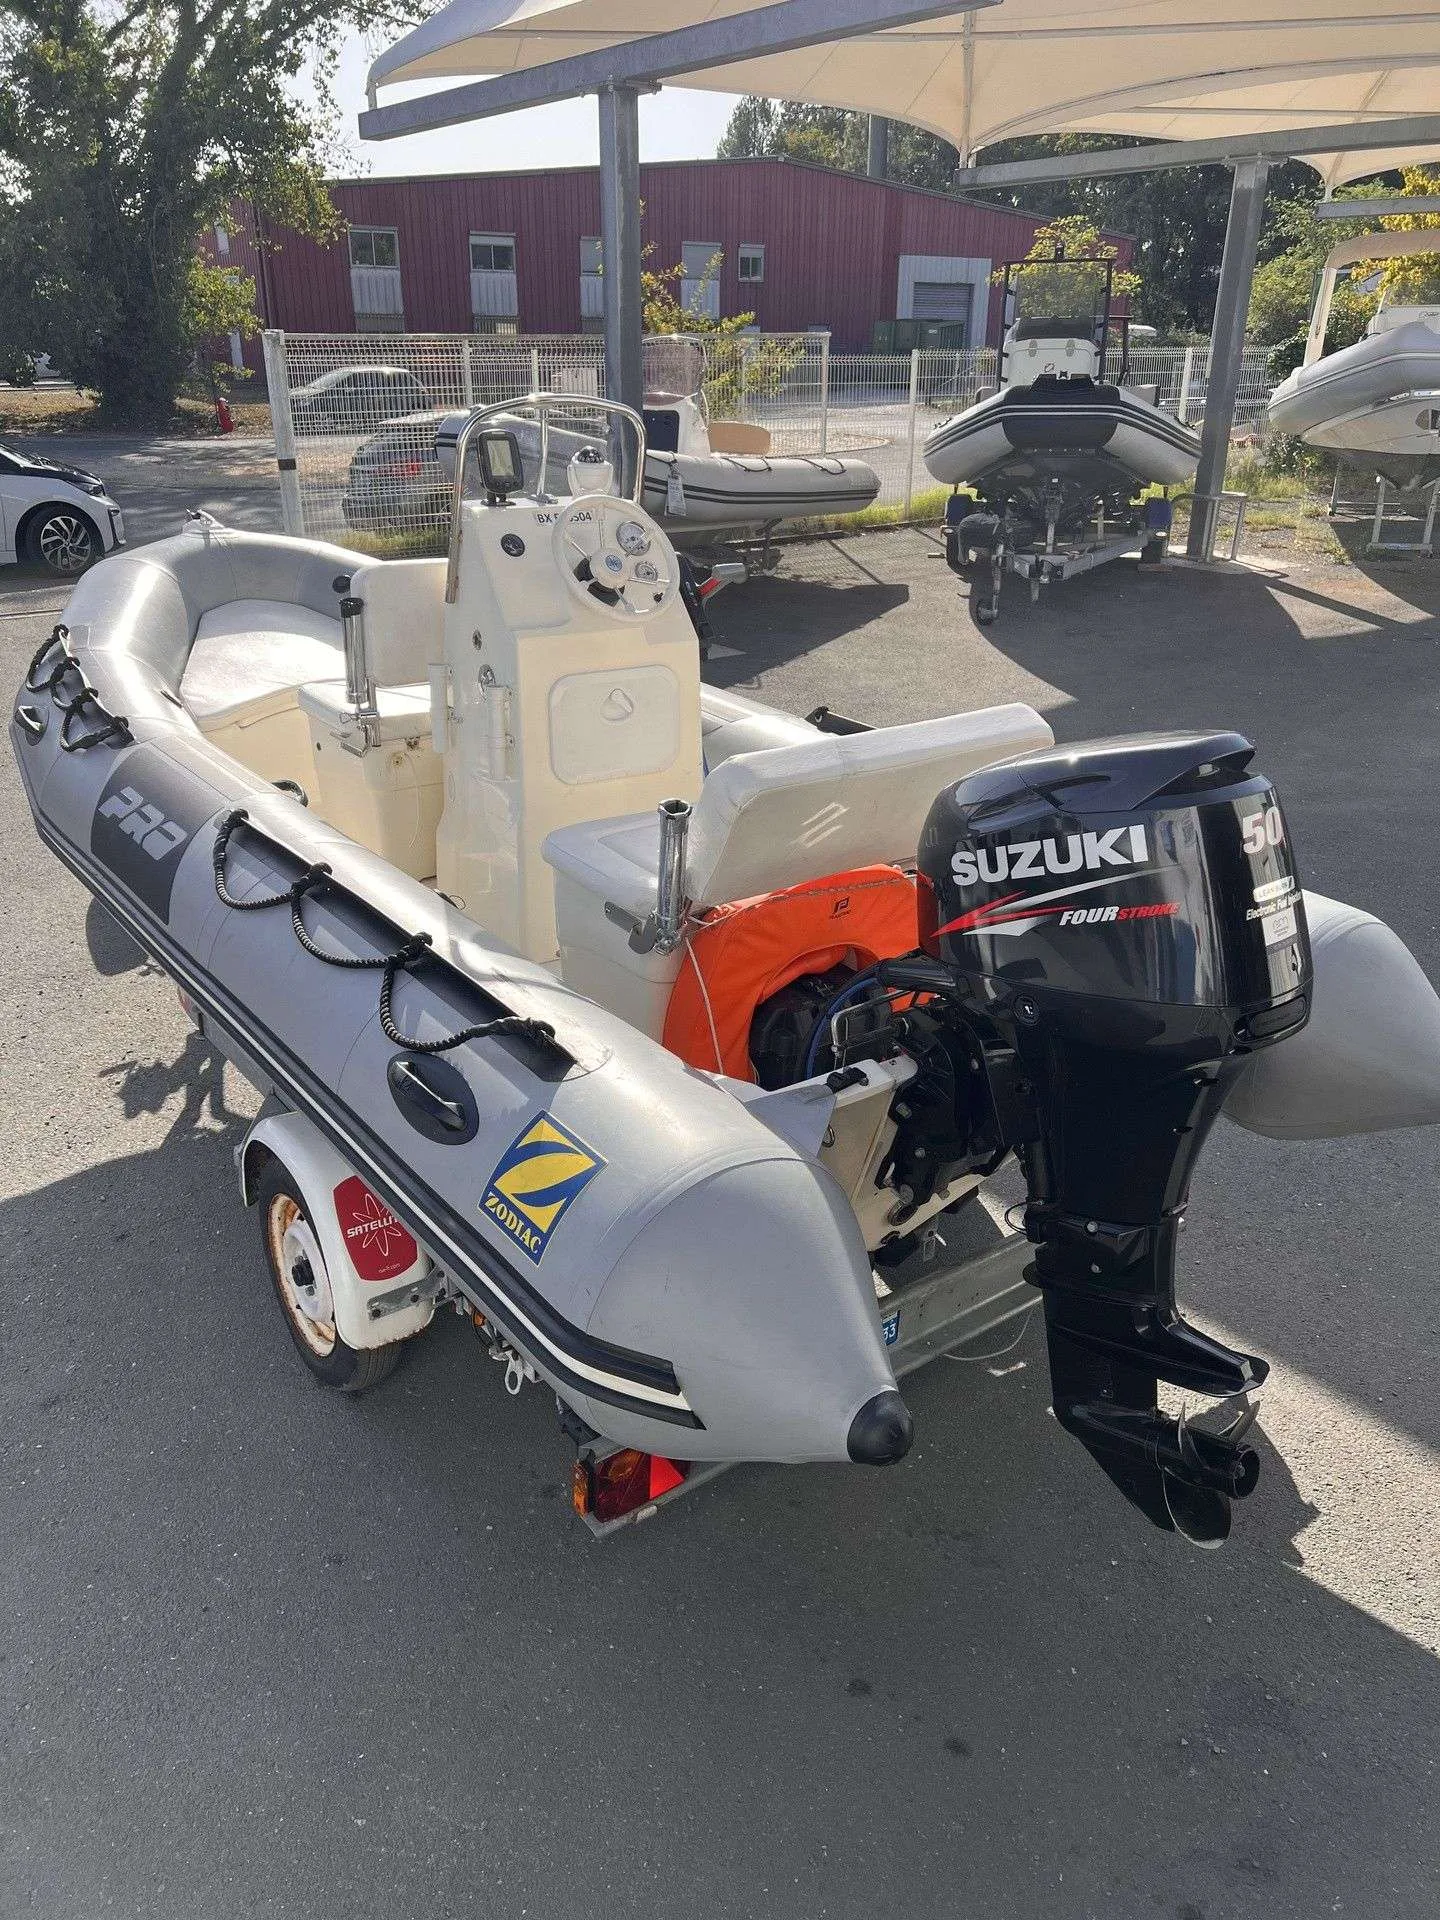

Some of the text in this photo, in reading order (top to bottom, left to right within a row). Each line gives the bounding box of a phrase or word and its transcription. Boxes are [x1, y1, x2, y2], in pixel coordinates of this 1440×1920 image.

[537, 513, 553, 523] BX
[98, 786, 187, 861] PRO
[1242, 806, 1285, 854] 50
[951, 824, 1149, 886] SUZUKI
[346, 1215, 398, 1238] SATELLI
[484, 1191, 541, 1254] ZODIAC
